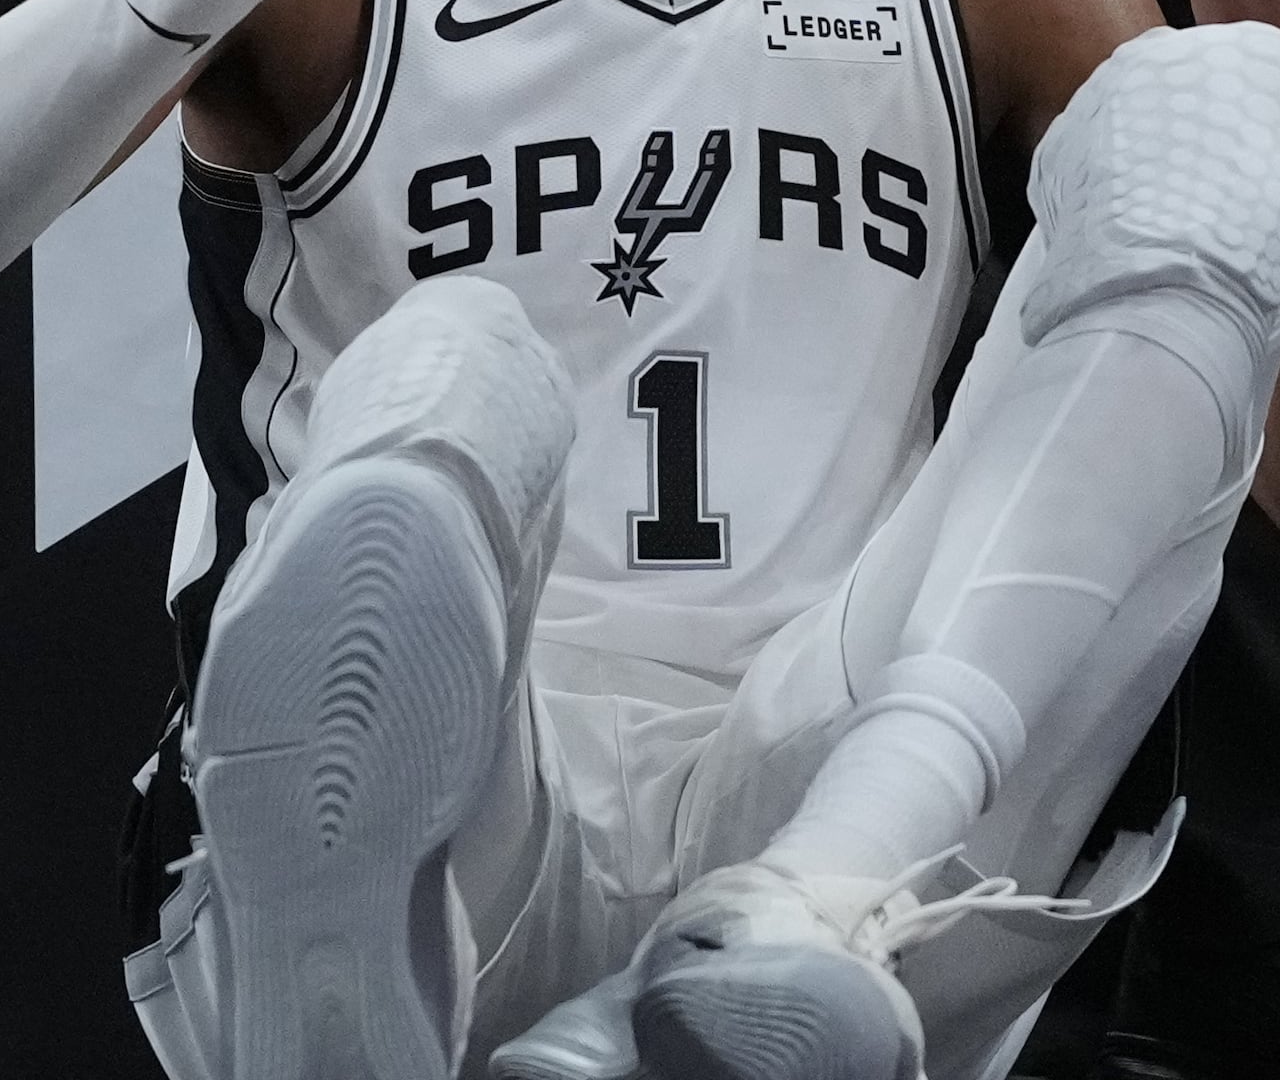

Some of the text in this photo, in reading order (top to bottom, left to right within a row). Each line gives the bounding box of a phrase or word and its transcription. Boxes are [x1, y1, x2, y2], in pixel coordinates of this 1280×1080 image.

[783, 15, 882, 41] LEDGER
[407, 128, 929, 318] SPURS
[626, 350, 731, 570] 1
